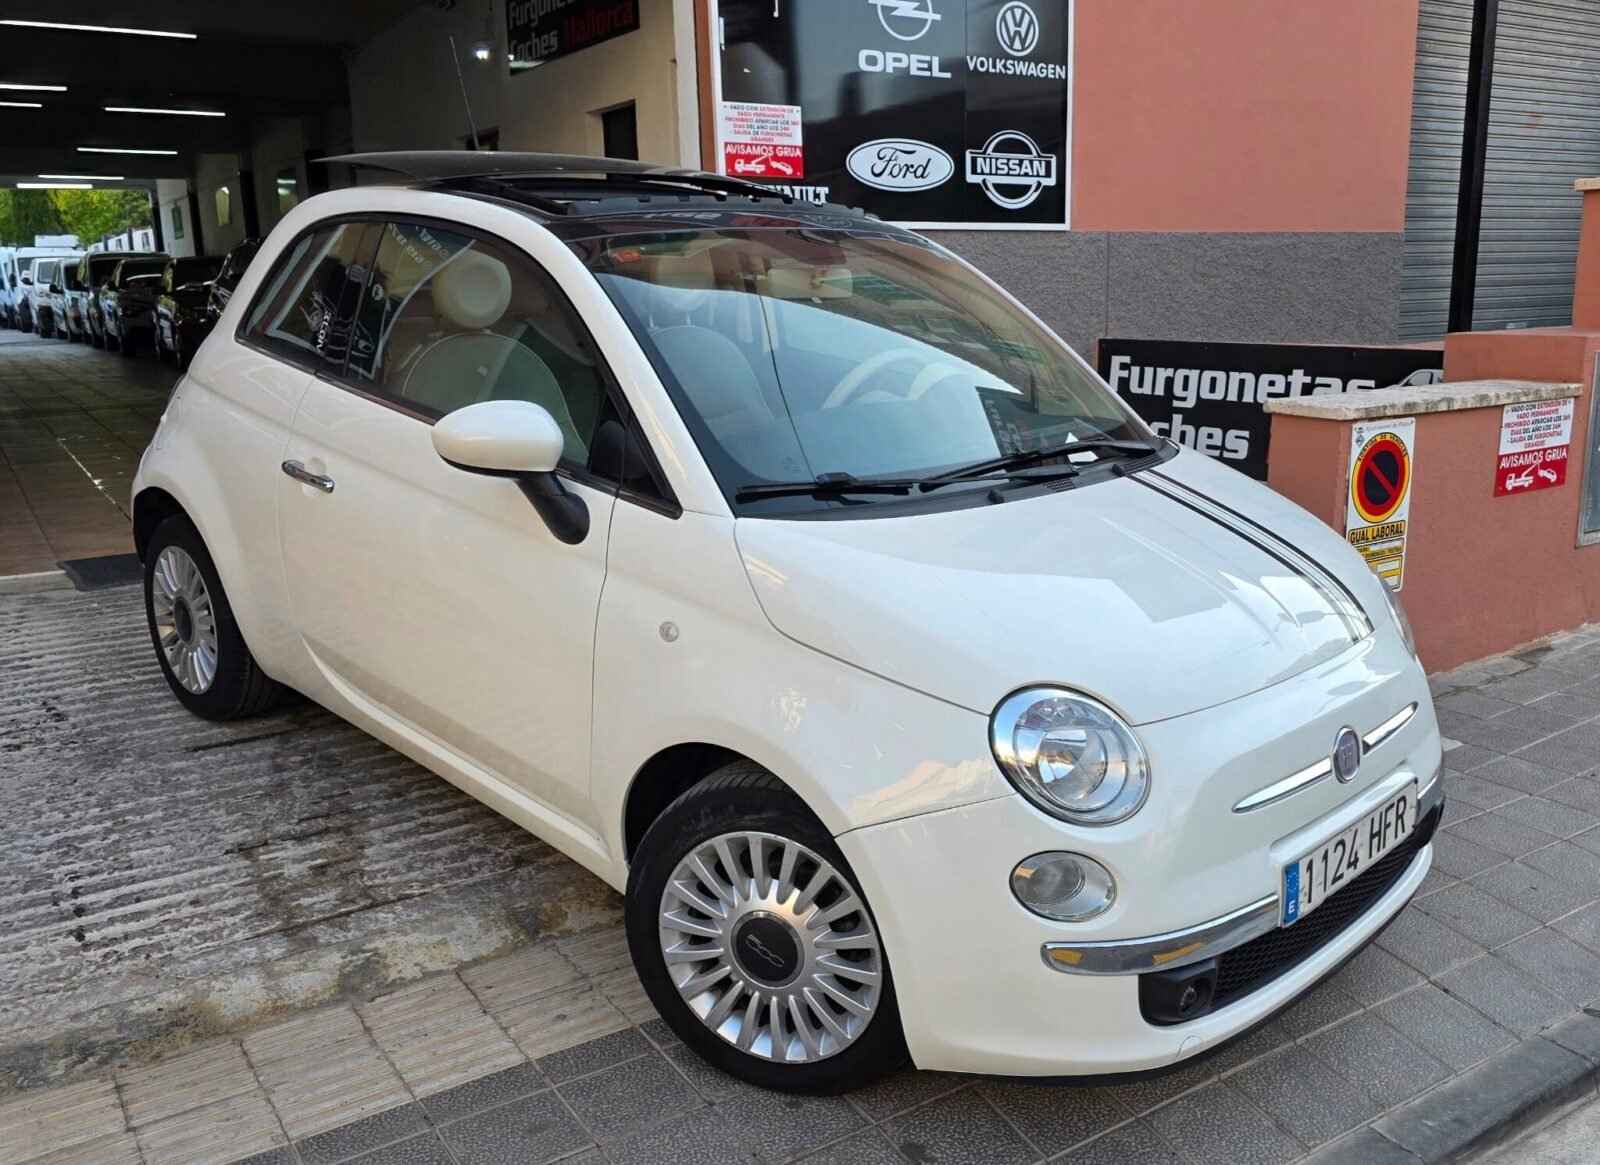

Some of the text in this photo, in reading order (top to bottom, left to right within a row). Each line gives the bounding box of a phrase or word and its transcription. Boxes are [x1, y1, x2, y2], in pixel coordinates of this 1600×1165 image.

[509, 0, 577, 29] Furgon
[563, 1, 633, 48] Mallorca
[858, 49, 952, 78] OPEL
[966, 56, 1067, 79] VOLKSWAGEN
[725, 143, 802, 158] AVISAMOS GRUA
[871, 147, 932, 180] Ford
[976, 157, 1046, 177] NISSAN
[765, 185, 829, 205] AULT
[1510, 404, 1525, 413] VADO
[1526, 403, 1537, 412] CON
[1516, 408, 1559, 420] VADO PERMANENTE
[1504, 419, 1531, 429] PROHIBIDO
[1531, 416, 1553, 426] APARCAR
[1532, 424, 1542, 433] AÑO
[1149, 413, 1250, 460] ches
[1510, 435, 1527, 444] SALIDA
[1534, 430, 1563, 440] FURGONETAS
[1499, 447, 1568, 469] AVISAMOS GRUA
[1350, 523, 1404, 544] GUAL LABORAL
[1288, 795, 1407, 914] E 1124 HFR
